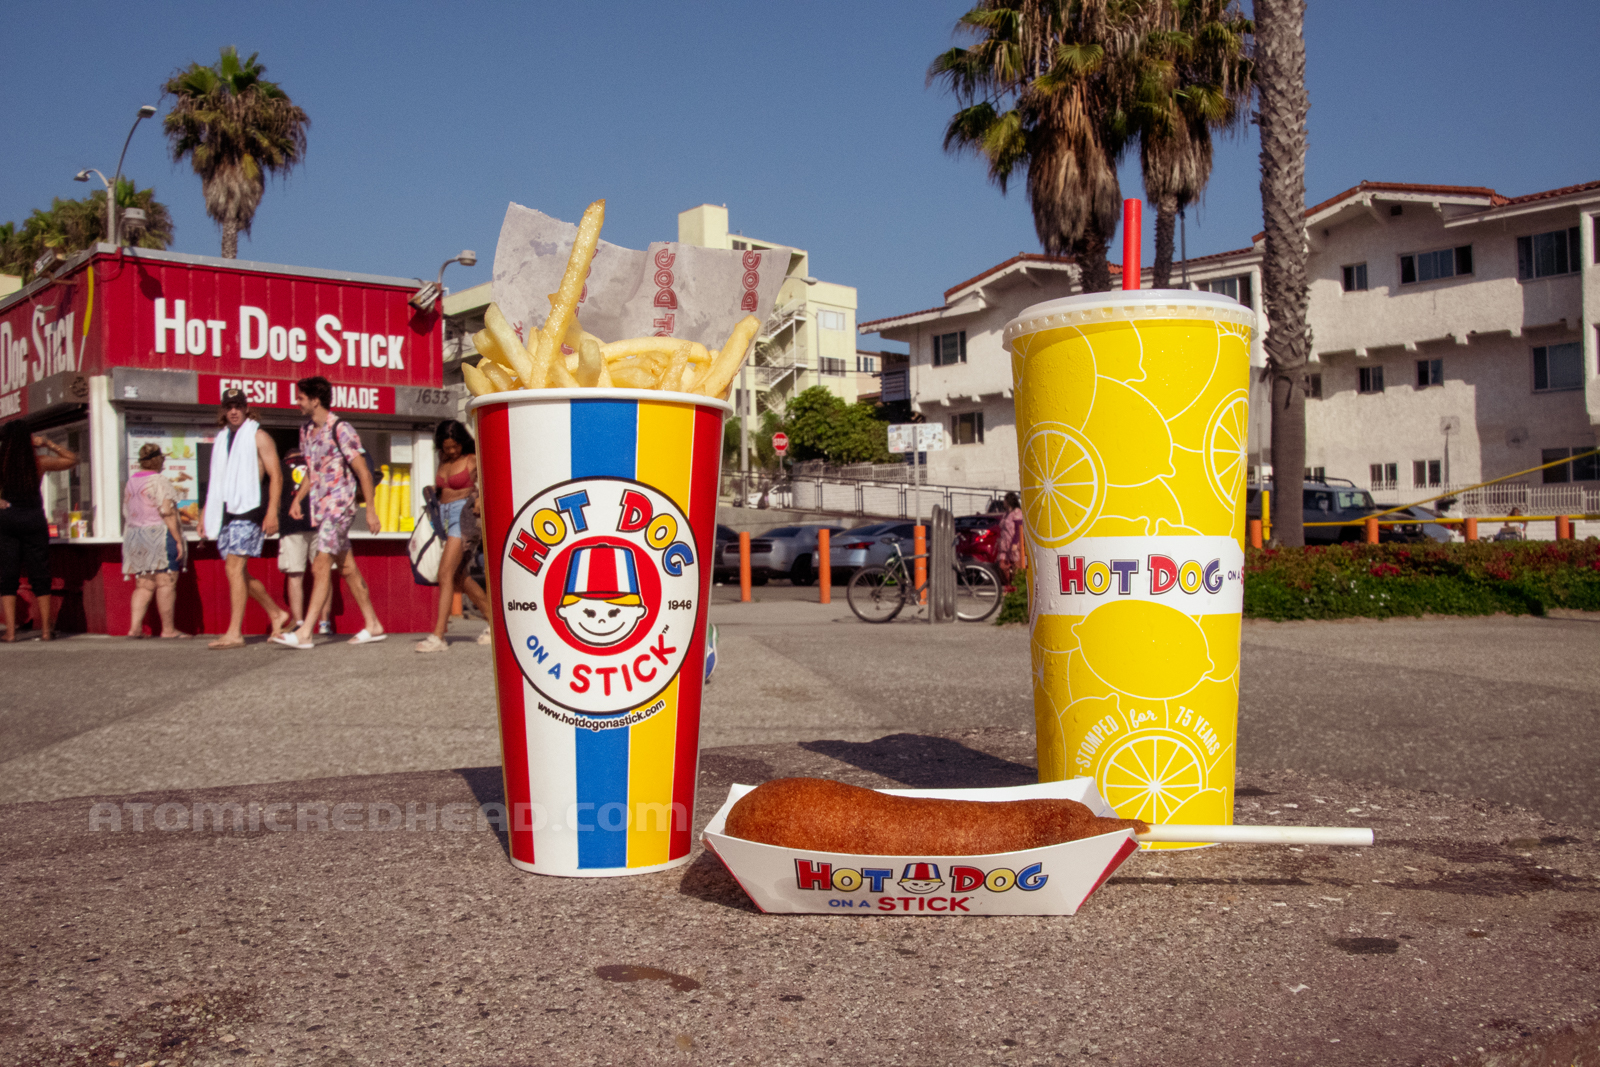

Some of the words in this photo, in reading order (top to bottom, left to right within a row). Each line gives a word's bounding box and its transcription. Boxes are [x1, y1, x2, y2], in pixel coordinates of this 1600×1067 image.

[654, 248, 678, 310] DOG
[741, 249, 761, 312] DOG
[154, 298, 227, 358] HOT
[239, 305, 307, 362] DOG
[315, 314, 405, 370] STICK
[0, 321, 28, 396] DOG
[415, 389, 450, 405] 1633
[773, 438, 788, 446] STOP
[508, 489, 591, 577] HOT
[616, 489, 694, 577] DOG
[1057, 554, 1139, 595] HOT
[1147, 554, 1224, 596] DOG
[1228, 570, 1236, 580] ON
[507, 599, 538, 611] since
[667, 599, 692, 611] 1946
[526, 635, 549, 664] ON
[548, 662, 561, 679] A
[569, 633, 677, 697] STICK
[537, 699, 665, 730] www.hotdogonastick.com
[1130, 708, 1157, 728] for
[1175, 706, 1194, 727] 75
[1193, 716, 1220, 756] YEARS
[794, 858, 893, 893] HOT
[949, 862, 1049, 893] DOG
[828, 899, 854, 908] ON
[858, 900, 871, 908] A
[877, 896, 970, 912] STICK
